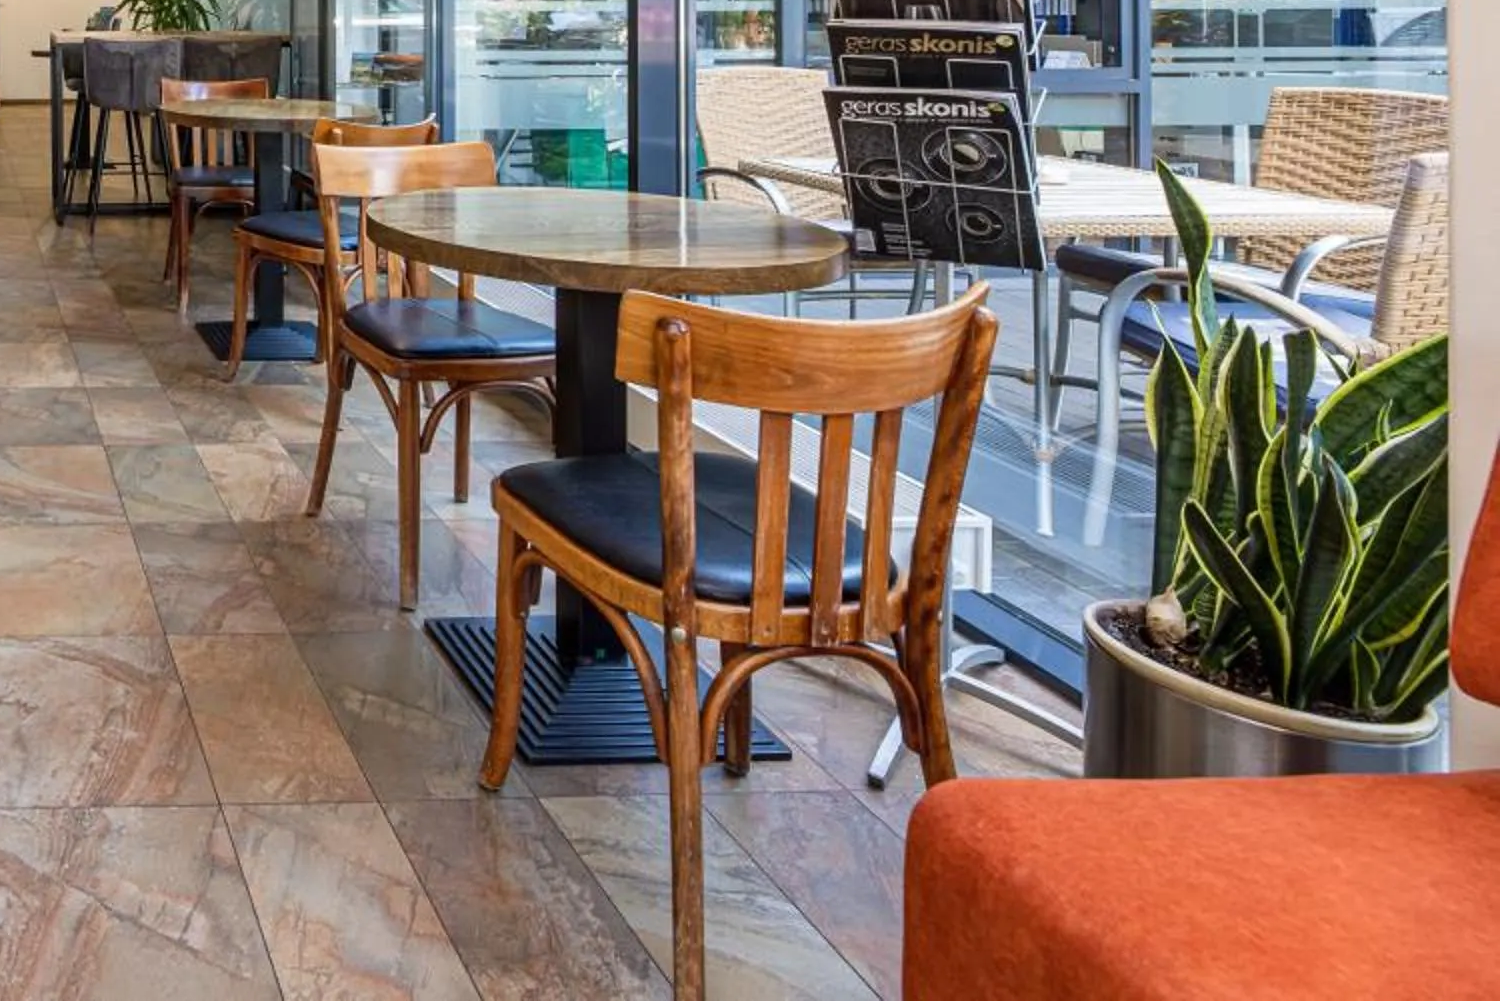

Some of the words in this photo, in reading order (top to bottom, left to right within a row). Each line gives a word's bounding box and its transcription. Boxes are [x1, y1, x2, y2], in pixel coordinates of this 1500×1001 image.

[845, 35, 907, 54] geras
[909, 32, 997, 55] skonis
[840, 100, 902, 119] geras
[903, 96, 992, 118] skonis
